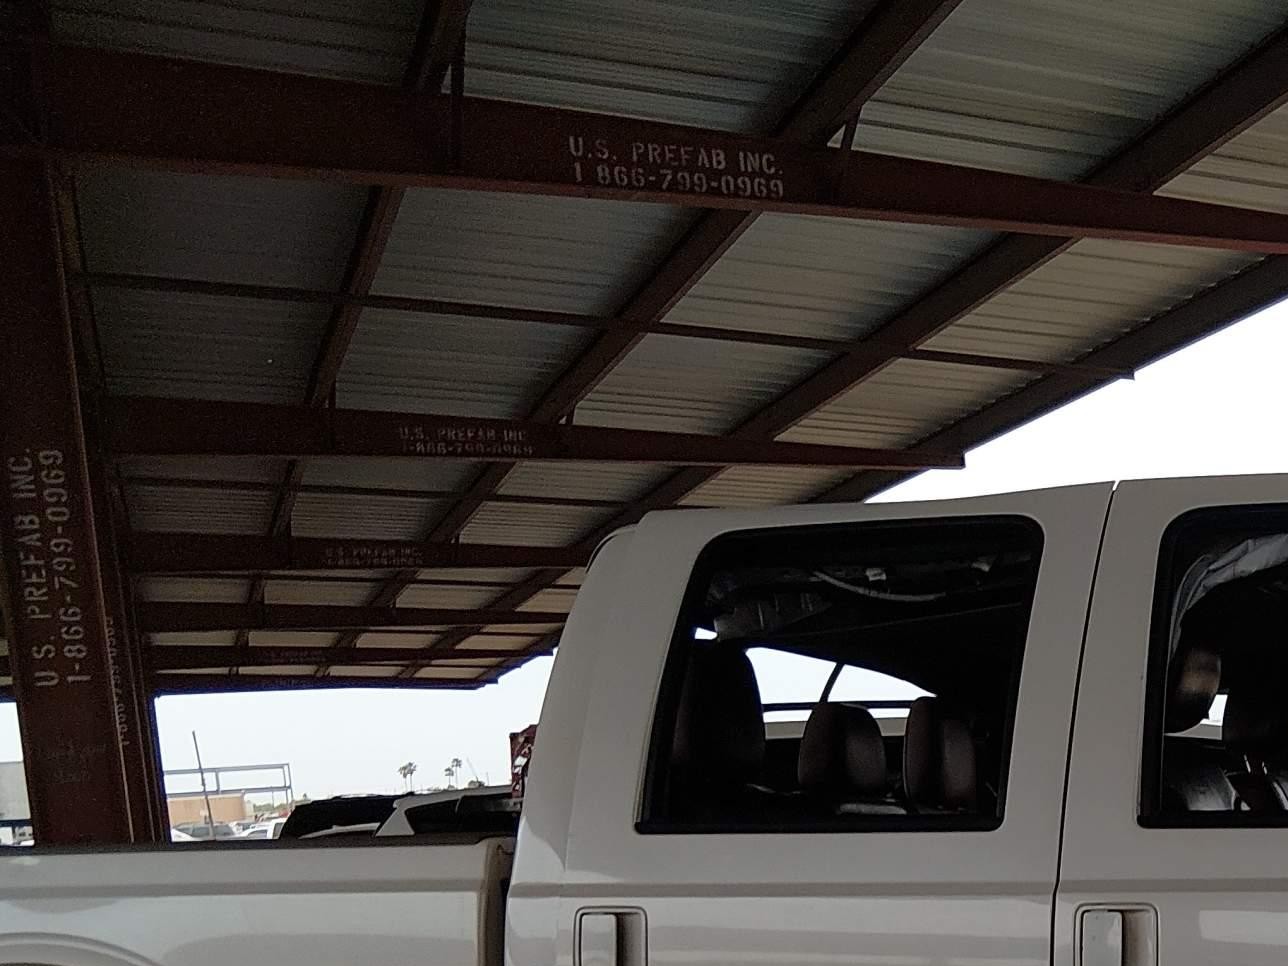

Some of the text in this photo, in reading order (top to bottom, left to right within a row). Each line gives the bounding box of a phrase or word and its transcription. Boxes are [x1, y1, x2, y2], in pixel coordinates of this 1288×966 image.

[568, 135, 784, 175] U.S. PREFAB INC.
[7, 448, 37, 499] INC.
[13, 513, 51, 619] PREFAB
[39, 449, 92, 683] 1-866-799-0969
